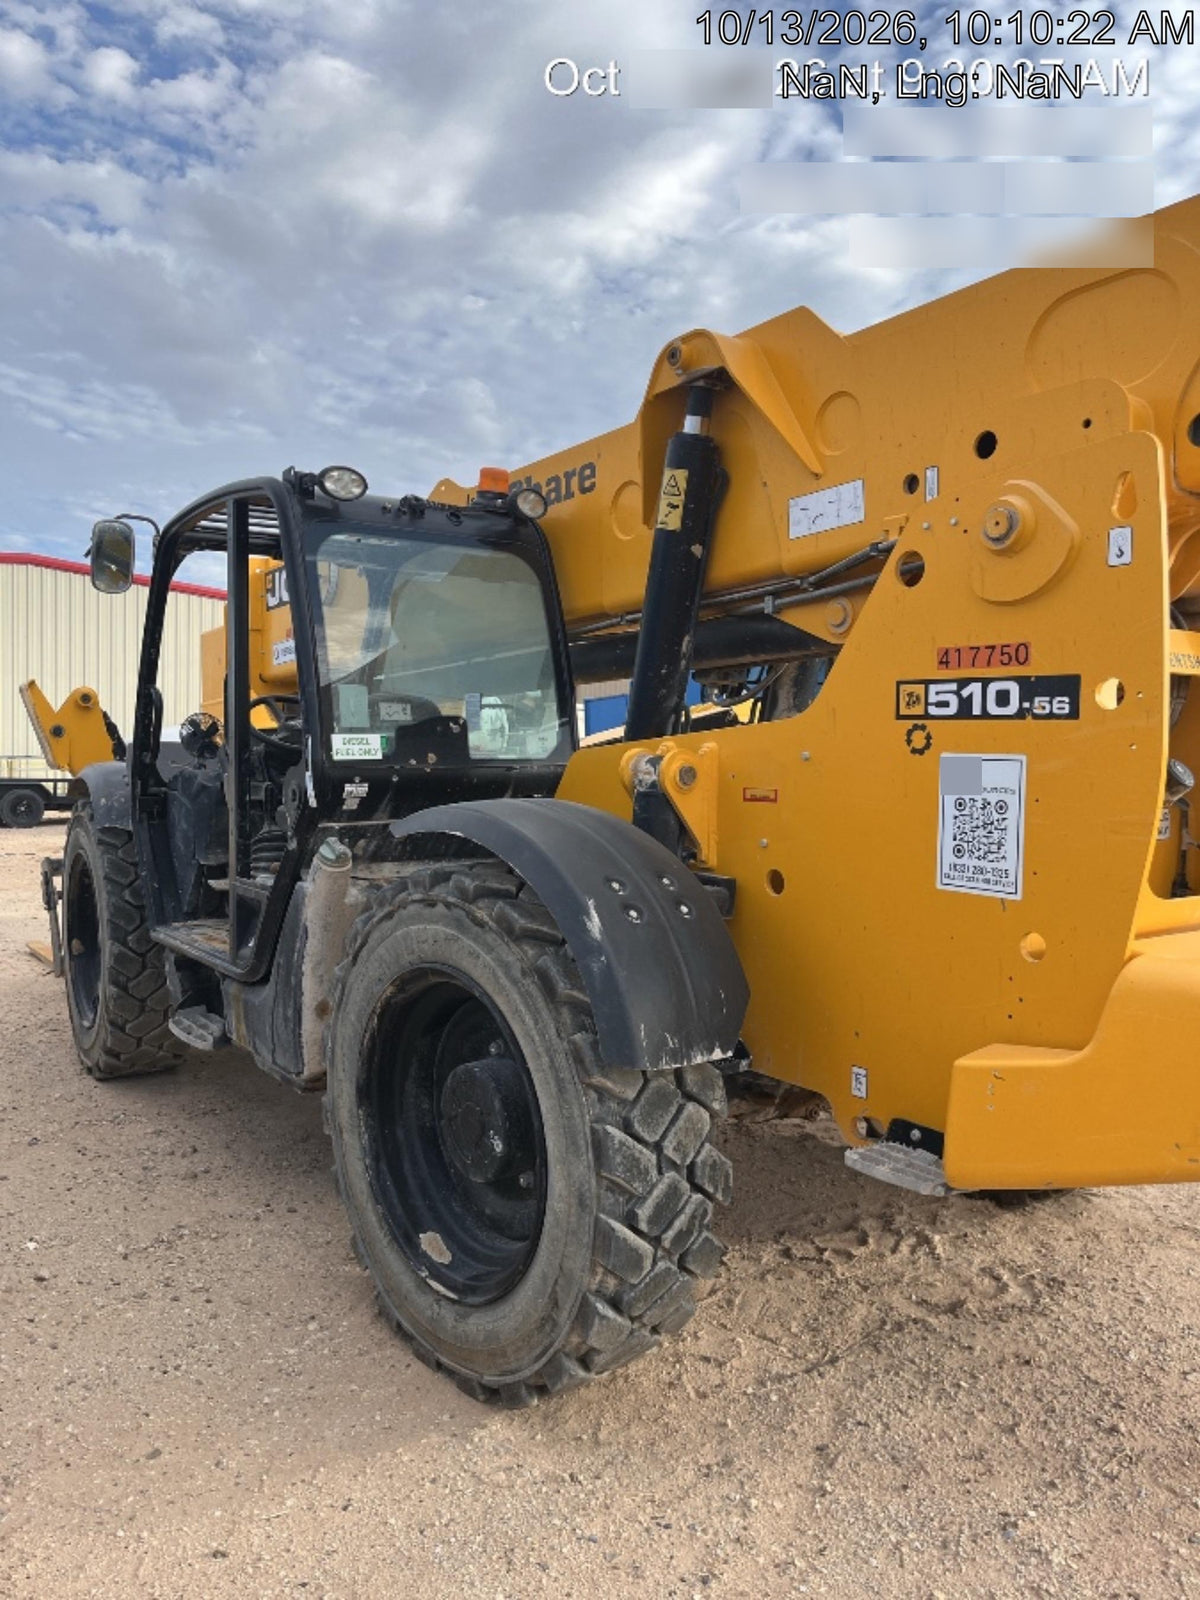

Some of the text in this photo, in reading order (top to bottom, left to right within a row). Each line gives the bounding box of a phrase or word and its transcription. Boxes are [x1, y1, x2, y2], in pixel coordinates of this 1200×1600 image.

[938, 642, 1029, 669] 417750
[335, 748, 379, 757] FUEL ONLY
